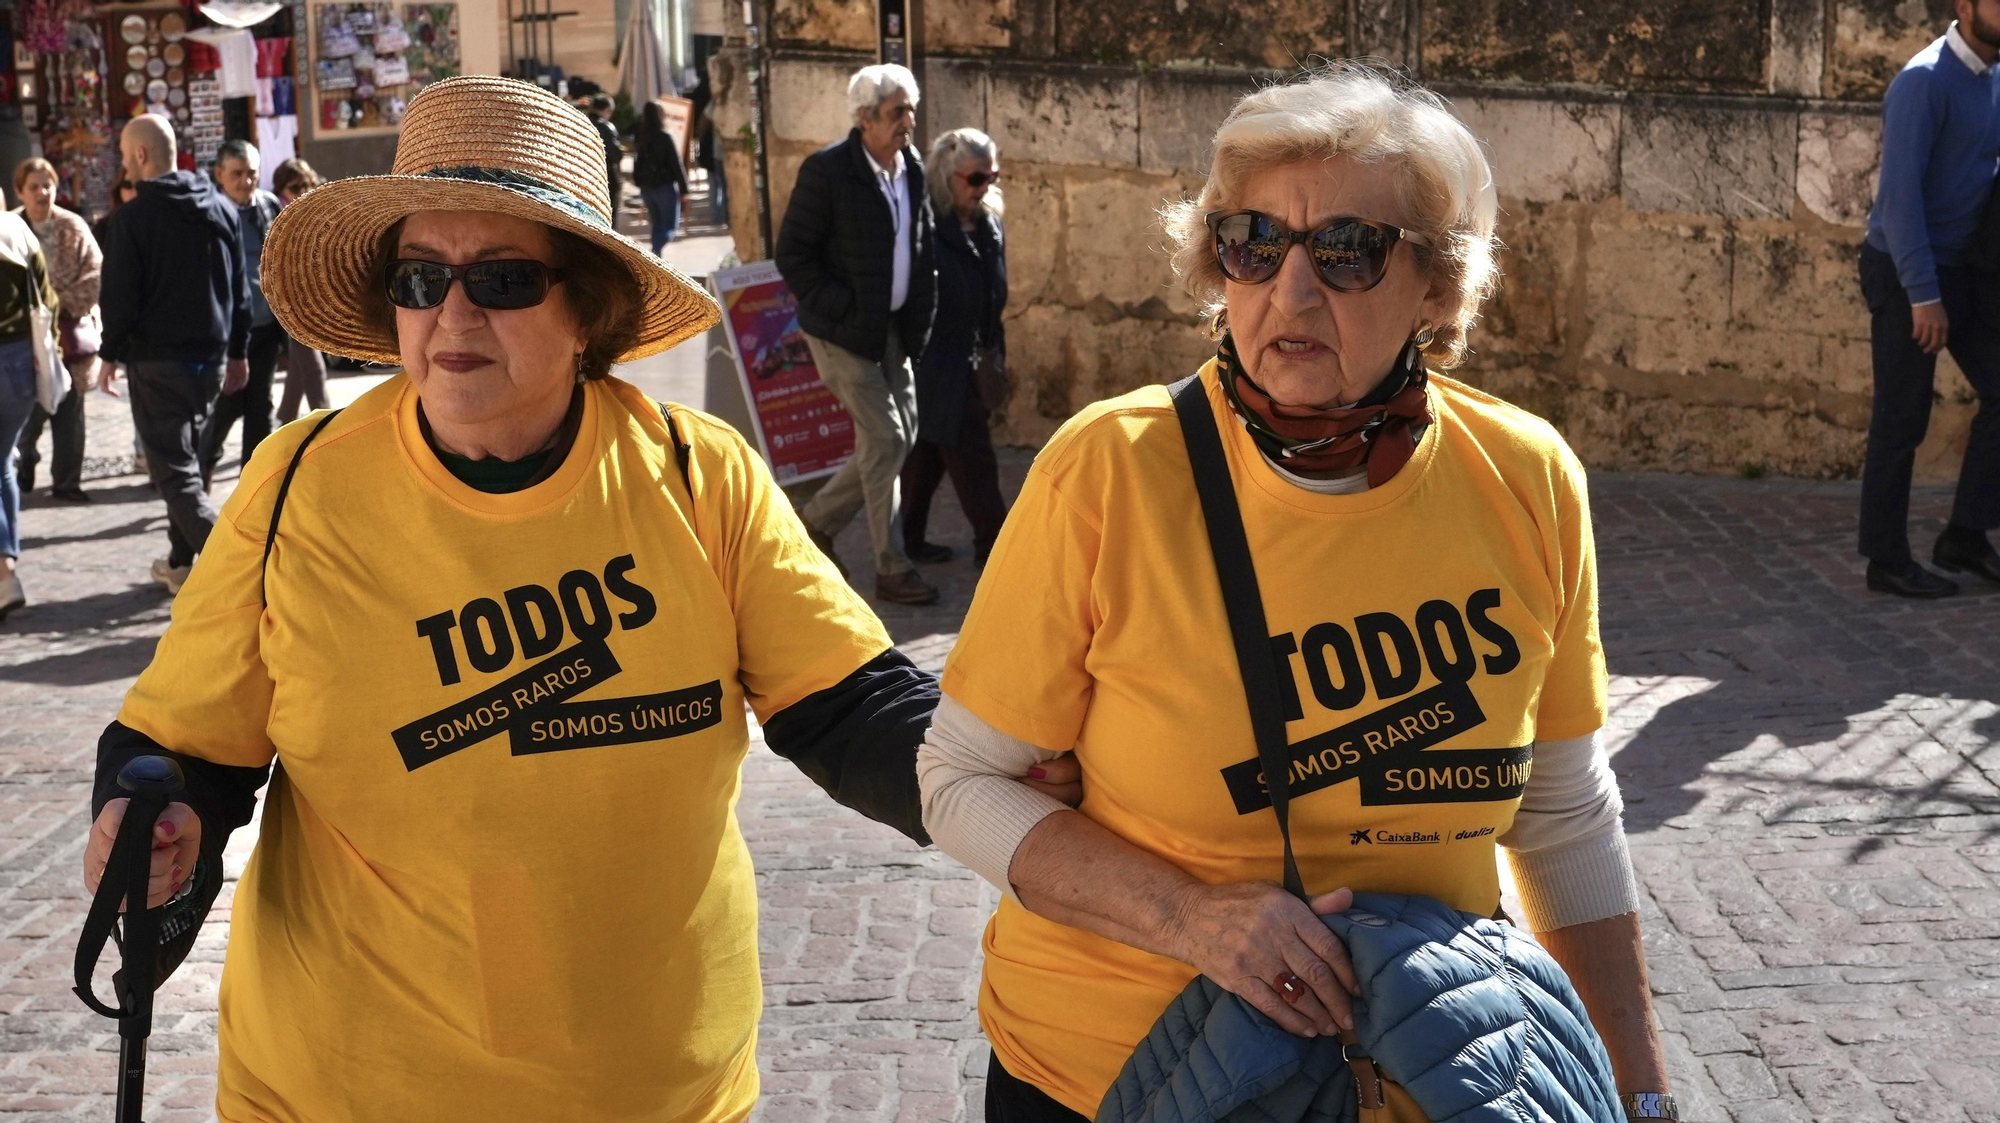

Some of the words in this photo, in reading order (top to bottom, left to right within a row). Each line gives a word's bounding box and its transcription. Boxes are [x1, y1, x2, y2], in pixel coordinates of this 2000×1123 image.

[416, 553, 657, 686] TODOS
[1268, 588, 1521, 722] TODOS
[420, 699, 510, 750] SOMOS
[511, 657, 592, 710] RAROS
[530, 713, 624, 742] SOMOS
[631, 697, 713, 731] ÚNICOS
[1257, 741, 1361, 794] MOS
[1363, 701, 1456, 754] RAROS
[1384, 766, 1490, 792] SOMOS
[1376, 830, 1440, 842] CaixaBank
